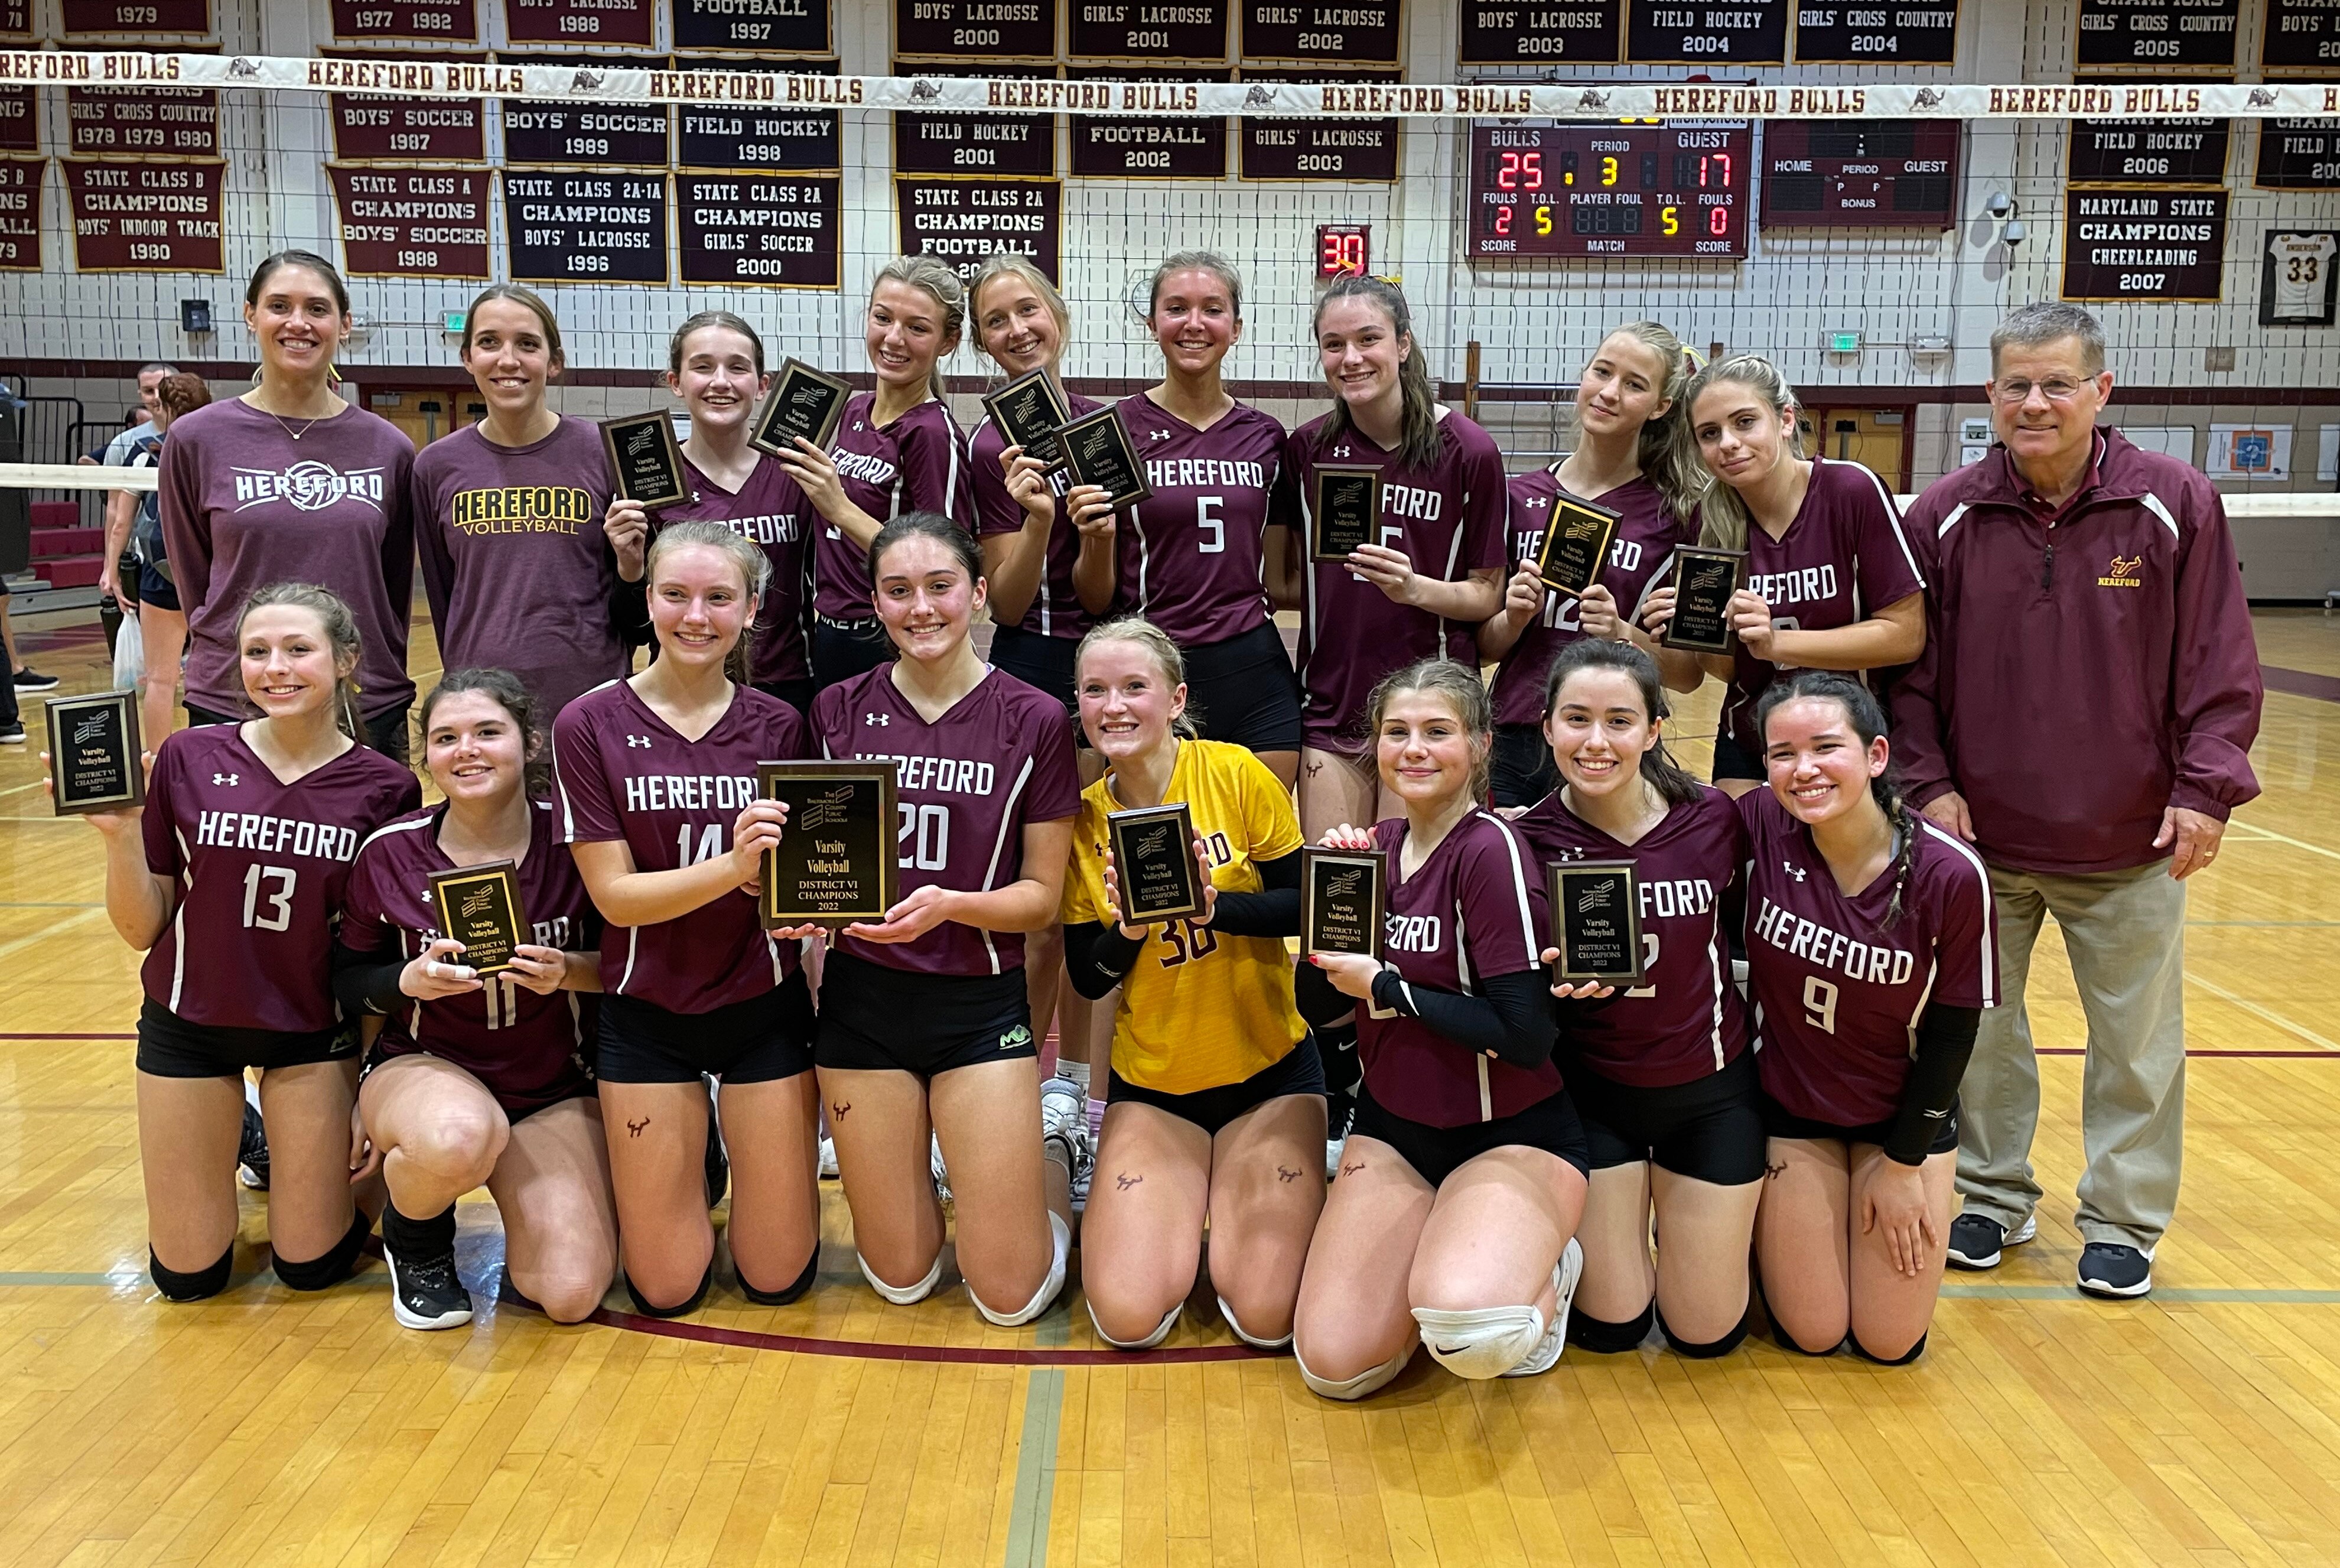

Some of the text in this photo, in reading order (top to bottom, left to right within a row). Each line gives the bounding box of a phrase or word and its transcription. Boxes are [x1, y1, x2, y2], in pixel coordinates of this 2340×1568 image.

[914, 3, 1039, 21] BOYS' LACROSSE
[1478, 12, 1603, 29] BOYS' LACROSSE
[1653, 11, 1763, 29] FIELD HOCKEY
[1799, 10, 1955, 29] GIRLS' CROSS COUNTRY
[954, 29, 1000, 45] 2000
[1517, 37, 1564, 54] 2003
[1682, 35, 1730, 53] 2004
[1851, 35, 1898, 53] 2004
[103, 56, 180, 80] BULLS
[308, 61, 523, 92] HEREFORD BULLS
[650, 73, 862, 103] HEREFORD BULLS
[988, 82, 1197, 110] HEREFORD BULLS
[1322, 87, 1531, 112] HEREFORD BULLS
[1654, 89, 1866, 113] HEREFORD BULLS
[1989, 88, 2201, 113] HEREFORD BULLS
[70, 103, 216, 123] GIRLS' CROSS COUNTRY
[344, 109, 474, 128] BOYS' SOCCER
[77, 127, 211, 147] 1978 1979 1980
[922, 123, 1029, 141] FIELD HOCKEY
[1091, 126, 1206, 144] FOOTBALL
[1256, 129, 1382, 147] GIRLS' LACROSSE
[1492, 131, 1541, 148] BULLS
[1678, 132, 1730, 148] GUEST
[390, 134, 430, 150] 1987
[1591, 141, 1630, 152] PERIOD
[2094, 133, 2204, 150] FIELD HOCKEY
[953, 149, 995, 165] 2001
[1297, 155, 1343, 171] 2003
[1775, 160, 1812, 172] HOME
[2123, 158, 2169, 174] 2006
[1499, 152, 1542, 188] 25
[1602, 157, 1618, 186] 3
[1700, 154, 1731, 187] 17
[1843, 164, 1879, 174] PERIOD
[1904, 160, 1948, 173] GUEST
[84, 170, 204, 188] STATE CLASS B
[351, 176, 471, 195] STATE CLASS A
[508, 179, 553, 197] STATE
[565, 180, 612, 198] CLASS
[693, 184, 822, 203] STATE CLASS 2A
[84, 194, 208, 213] CHAMPIONS
[914, 189, 1044, 207] STATE CLASS 2A
[1482, 193, 1518, 204] FOULS
[1530, 193, 1560, 204] T.O.L.
[1570, 193, 1643, 205] PLAYER FOUL
[1656, 194, 1686, 205] T.O.L.
[1698, 194, 1733, 206] FOULS
[1841, 199, 1876, 208] BONUS
[2079, 198, 2215, 216] MARYLAND STATE
[351, 200, 476, 219] CHAMPIONS
[522, 205, 651, 225] CHAMPIONS
[694, 209, 823, 229] CHAMPIONS
[914, 214, 1044, 232] CHAMPIONS
[1495, 206, 1512, 233] 2
[1535, 206, 1553, 235] 5
[1661, 207, 1678, 235] 5
[1710, 207, 1727, 235] 0
[77, 219, 220, 239] BOYS' INDOOR TRACK
[343, 225, 487, 245] BOYS' SOCCER
[2079, 223, 2212, 241] CHAMPIONS
[525, 229, 650, 249] BOYS' LACROSSE
[704, 233, 813, 253] GIRLS' SOCCER
[921, 238, 1037, 256] FOOTBALL
[1481, 240, 1516, 252] SCORE
[1587, 240, 1625, 252] MATCH
[1695, 240, 1732, 252] SCORE
[130, 243, 171, 261] 1980
[397, 251, 438, 267] 1988
[1324, 235, 1363, 269] 30
[2091, 248, 2198, 266] CHEERLEADING
[567, 255, 610, 272] 1996
[736, 259, 782, 276] 2000
[2287, 256, 2318, 282] 33
[2120, 274, 2166, 290] 2007
[1146, 459, 1264, 489] HEREFORD
[236, 474, 383, 502] HEREFORD
[452, 487, 591, 527] HEREFORD
[463, 520, 579, 535] VOLLEYBALL
[1197, 496, 1225, 553] 5
[1749, 564, 1837, 605] REFORD
[2098, 577, 2140, 587] HEREFORD
[624, 775, 759, 812] HEREFOR
[197, 810, 357, 862] HEREFORD
[897, 802, 949, 871] 20
[677, 824, 722, 868] 14
[815, 840, 846, 857] Varsity
[807, 860, 850, 876] Volleyball
[799, 880, 858, 889] DISTRICT VI
[243, 863, 297, 932] 13
[798, 891, 858, 900] CHAMPIONS
[818, 902, 838, 910] 2022
[1332, 903, 1353, 913] Varsity
[471, 920, 493, 929] Varsity
[1328, 912, 1358, 922] Volleyball
[1586, 919, 1609, 928] Varsity
[468, 928, 499, 938] Volleyball
[1322, 933, 1361, 942] CHAMPIONS
[1323, 926, 1352, 935] DISTRICT
[1582, 929, 1615, 938] Volleyball
[467, 942, 496, 951] DISTRICT
[1754, 896, 1914, 984] HEREFORD
[468, 946, 508, 958] CHAMPIONS
[483, 977, 516, 1030] 11
[1803, 975, 1838, 1035] 9
